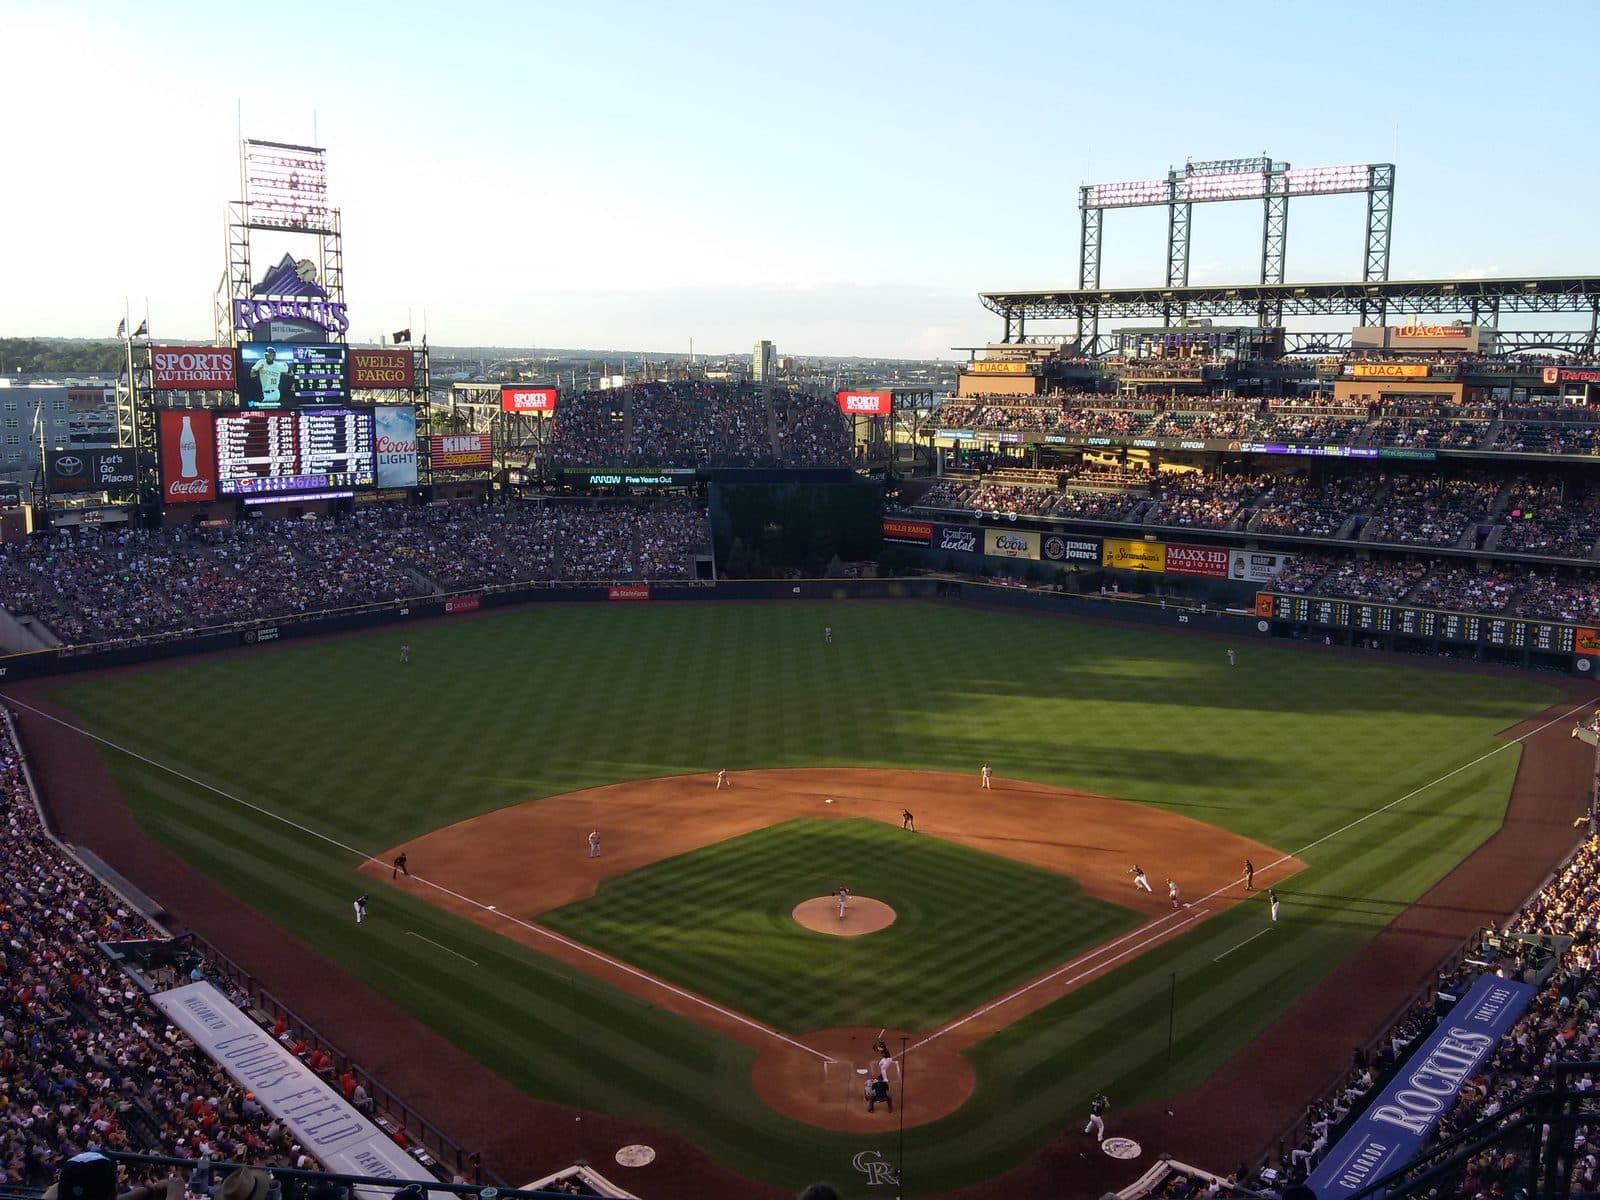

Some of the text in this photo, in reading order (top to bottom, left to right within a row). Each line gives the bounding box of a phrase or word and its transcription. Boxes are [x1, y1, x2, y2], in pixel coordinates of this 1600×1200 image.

[233, 298, 350, 334] ROCKIES
[1397, 326, 1445, 336] TUACA
[155, 353, 233, 371] SPORTS
[355, 356, 405, 368] WELLS
[979, 363, 1009, 372] TUACA
[157, 371, 233, 381] AUTHORITY
[357, 370, 405, 381] FARGO
[1361, 366, 1403, 375] TUACA
[514, 393, 546, 402] SPORTS
[847, 396, 879, 405] SPORTS
[376, 436, 417, 453] Coors
[442, 436, 480, 453] KING
[100, 455, 123, 464] Let's
[380, 453, 414, 465] LIGHT
[100, 465, 114, 473] Go
[101, 473, 134, 483] Places
[590, 475, 621, 484] ARROW
[640, 476, 659, 484] Years
[169, 479, 209, 495] Coca-Cola
[883, 523, 931, 535] WELLS FARGO
[941, 537, 976, 552] dental
[996, 535, 1028, 551] Coors
[1066, 541, 1098, 551] JIMMY
[1066, 550, 1097, 560] JOHN'S
[1115, 547, 1160, 561] Stranahan's
[1168, 548, 1227, 563] MAXX HD
[1167, 559, 1226, 570] sunglasses
[184, 998, 227, 1030] WELCOME TO
[1475, 1003, 1500, 1022] SINCE
[1369, 1026, 1494, 1137] ROCKIES
[214, 1033, 364, 1145] COORS FIELD
[1339, 1142, 1387, 1190] COLORADO
